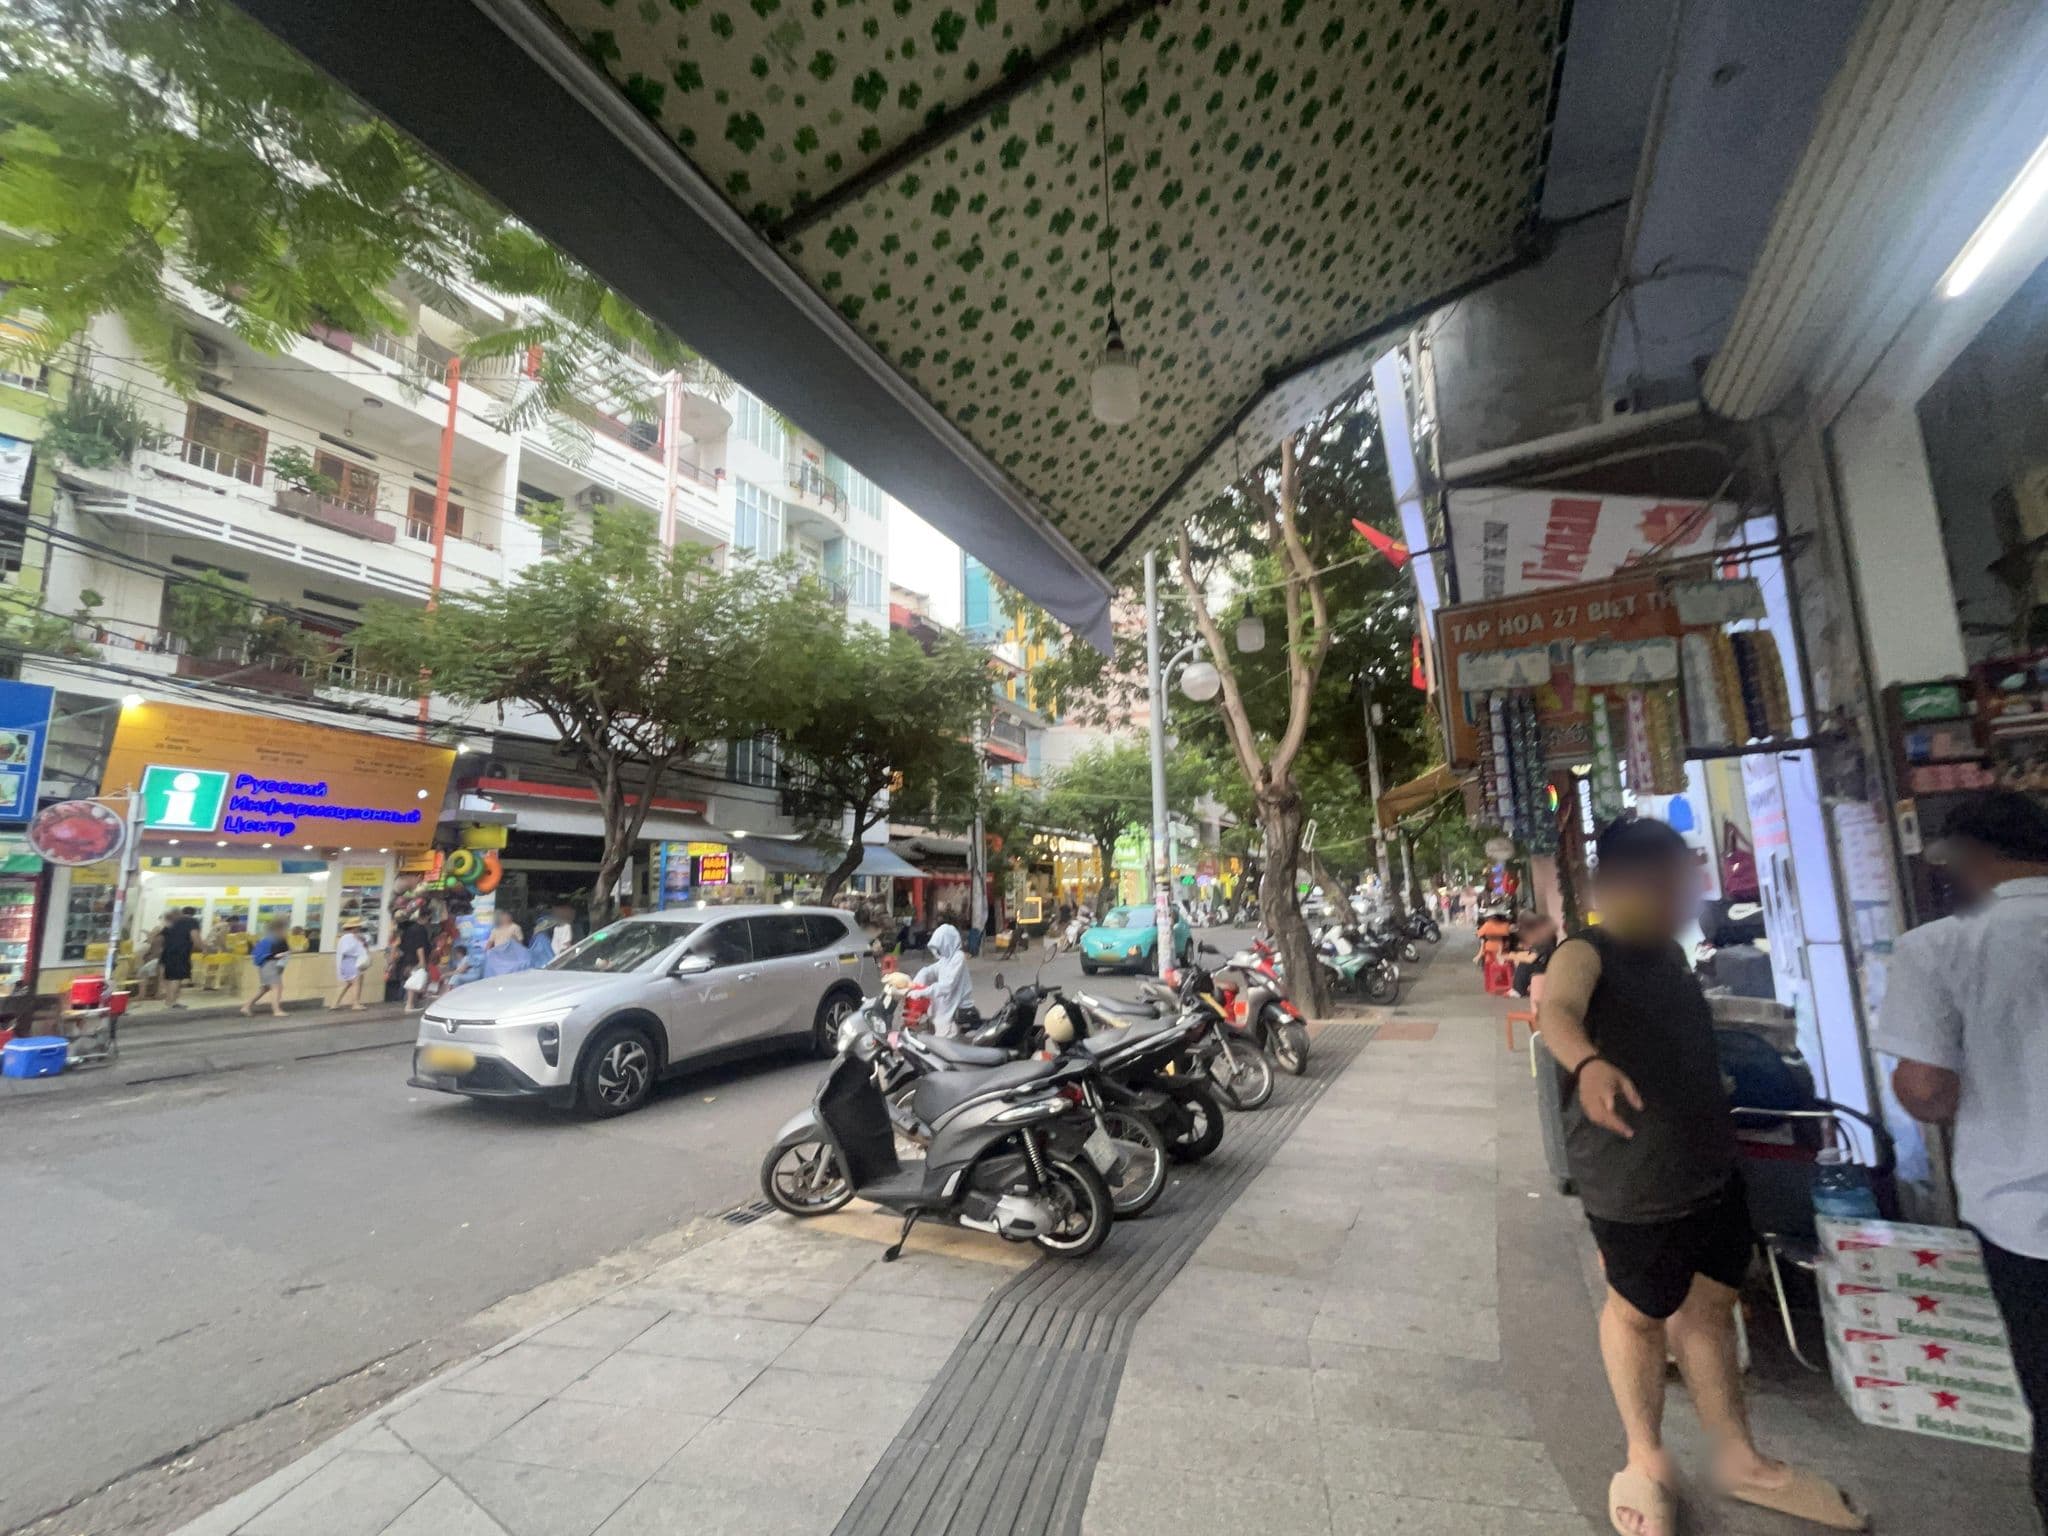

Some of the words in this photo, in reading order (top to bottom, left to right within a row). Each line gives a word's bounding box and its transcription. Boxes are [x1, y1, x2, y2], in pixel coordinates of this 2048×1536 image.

[1552, 605, 1579, 629] 27
[235, 774, 328, 797] Русский
[224, 815, 296, 837] Центр
[1904, 1366, 2016, 1397] Heineken
[1916, 1414, 2025, 1446] Heineken
